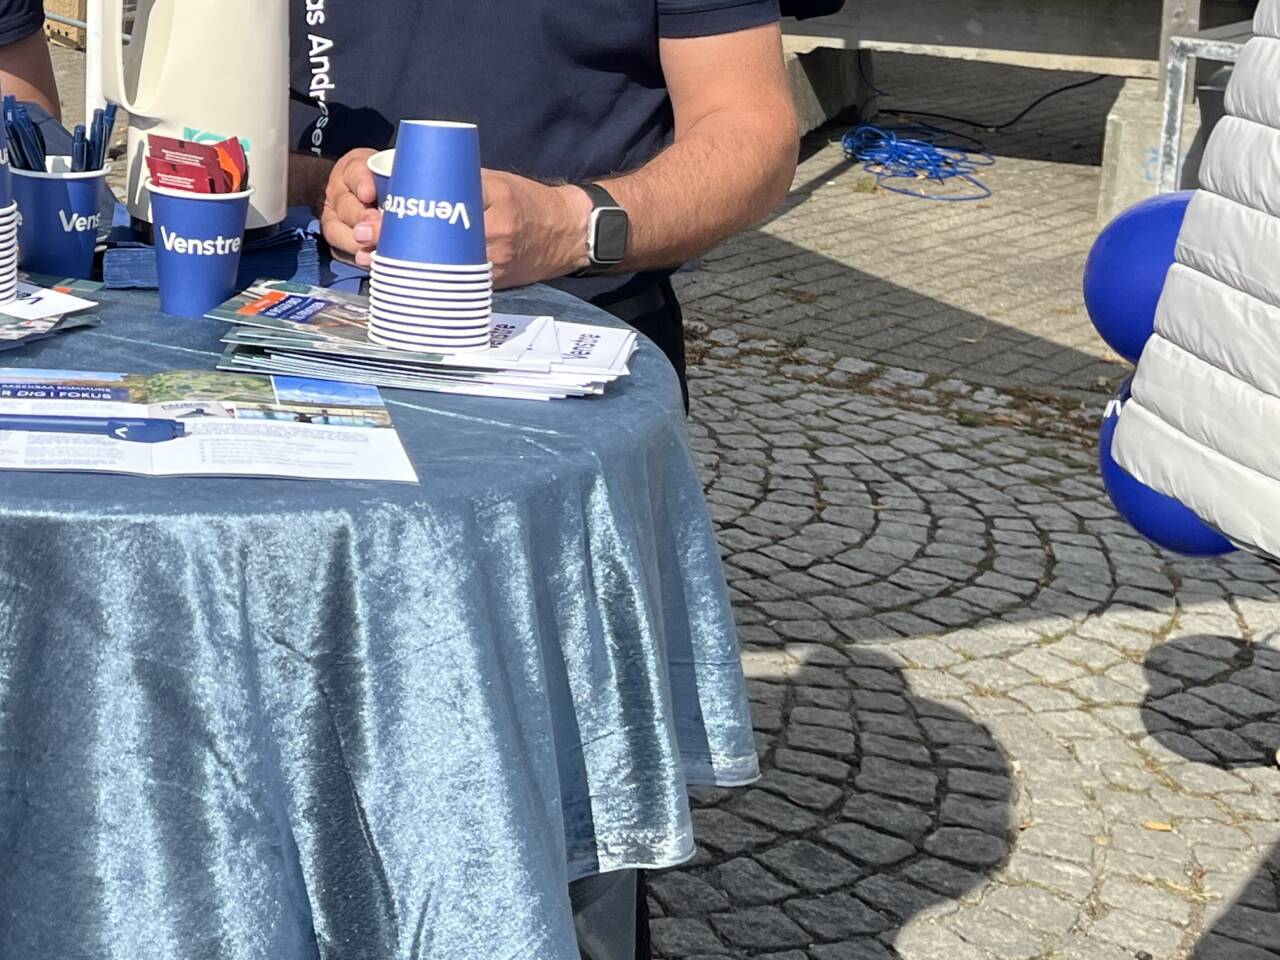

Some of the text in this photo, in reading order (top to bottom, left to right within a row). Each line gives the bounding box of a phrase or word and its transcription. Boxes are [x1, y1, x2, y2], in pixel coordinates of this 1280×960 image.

[58, 209, 101, 232] Vens
[385, 193, 470, 231] Venstre
[160, 225, 241, 256] Venstre
[16, 389, 47, 398] DIG
[59, 390, 112, 400] FOKUS
